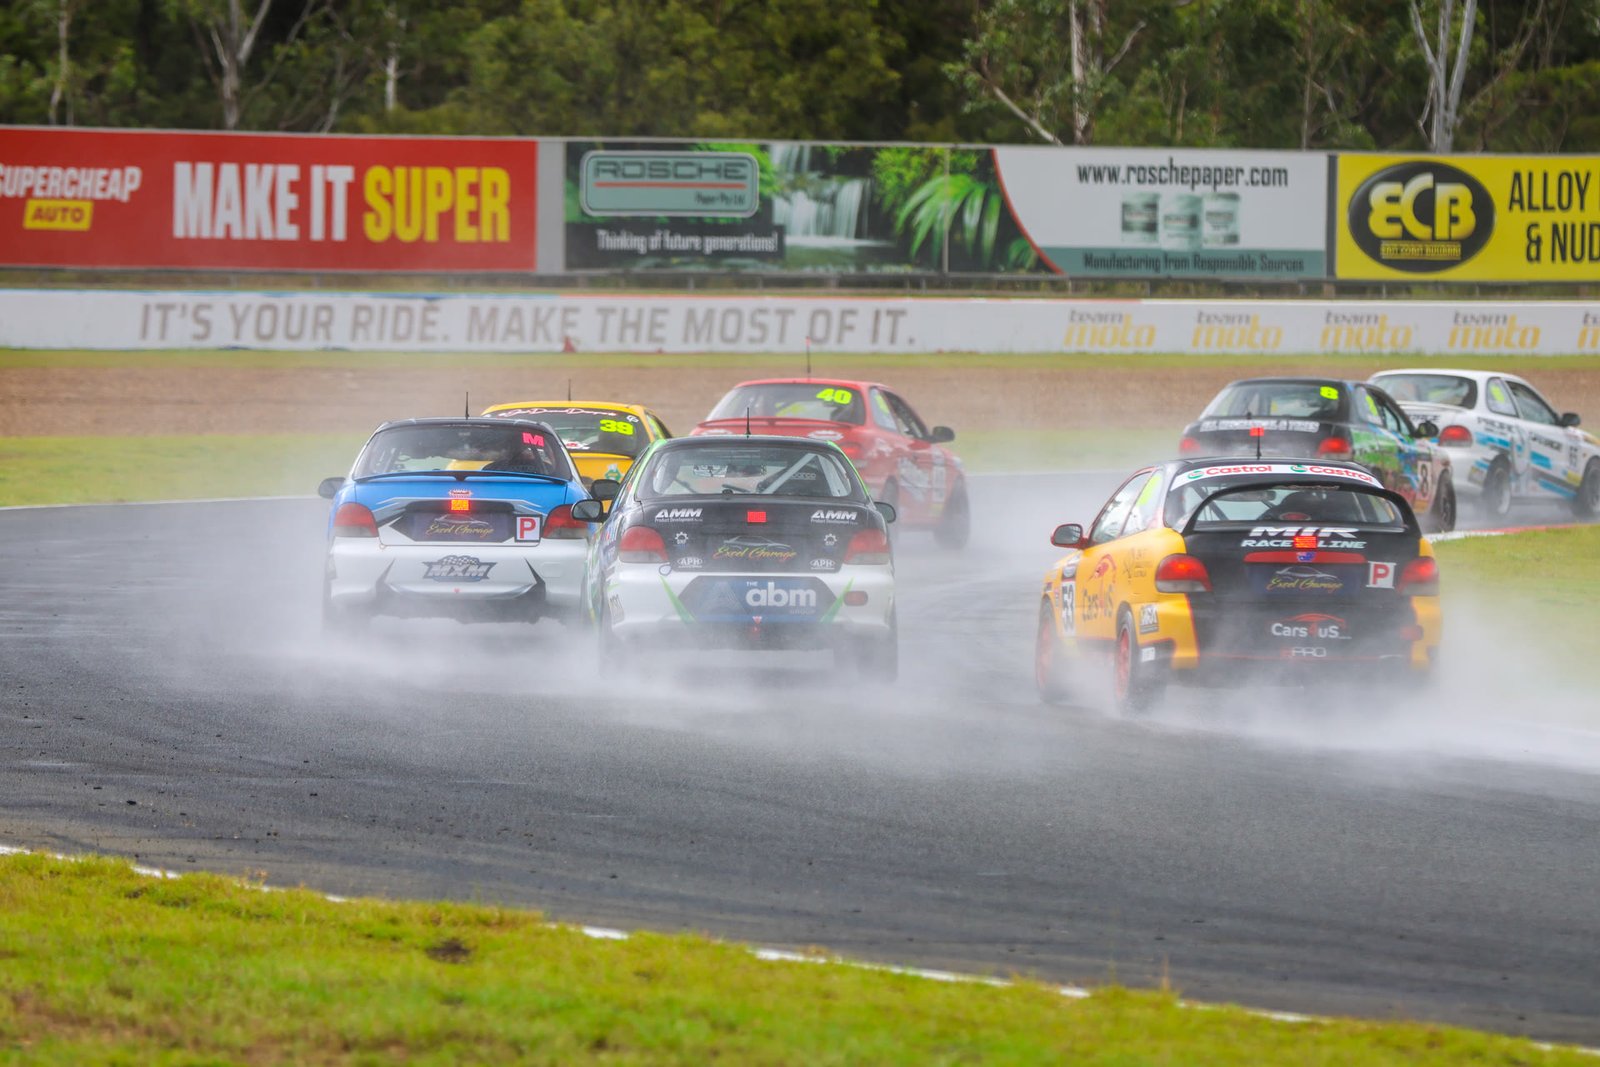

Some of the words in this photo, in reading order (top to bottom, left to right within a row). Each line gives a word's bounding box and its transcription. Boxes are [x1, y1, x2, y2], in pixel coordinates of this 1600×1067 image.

[593, 160, 748, 180] ROSCHE
[1077, 157, 1289, 192] www.roschepaper.com
[1508, 170, 1590, 212] ALLOY
[173, 161, 300, 240] MAKE
[310, 164, 355, 241] IT
[363, 165, 511, 243] SUPER
[1368, 172, 1476, 241] ECB
[31, 207, 85, 222] AUTO
[597, 229, 647, 254] Thinking
[648, 230, 663, 250] of
[663, 230, 702, 251] future
[703, 231, 778, 254] generations!
[1526, 221, 1542, 262] &
[1083, 252, 1161, 273] Manufacturing
[1164, 254, 1190, 271] from
[1194, 254, 1256, 274] Responsible
[1260, 255, 1304, 272] Sources
[139, 302, 213, 341] IT'S
[229, 302, 336, 342] YOUR
[349, 303, 450, 343] RIDE.
[465, 305, 580, 345] MAKE
[596, 306, 669, 345] THE
[682, 307, 795, 346] MOST
[807, 308, 859, 346] OF
[869, 309, 916, 347] IT.
[1070, 309, 1123, 324] team
[1197, 310, 1250, 324] team
[1325, 311, 1378, 325] team
[1454, 311, 1507, 325] team
[1063, 314, 1156, 348] moto
[1191, 314, 1283, 349] moto
[1320, 314, 1412, 349] moto
[1447, 314, 1541, 349] moto
[816, 387, 852, 405] 40
[1320, 386, 1338, 400] 8
[600, 419, 633, 436] 39
[522, 432, 545, 447] M
[1206, 465, 1272, 477] Castrol
[1309, 466, 1374, 483] Castrol
[1419, 460, 1428, 499] 8
[655, 508, 703, 518] AMM
[811, 509, 858, 520] AMM
[520, 518, 537, 539] P
[1249, 526, 1359, 538] MIR
[1240, 539, 1292, 548] RACE
[1317, 540, 1368, 549] LINE
[680, 557, 701, 565] APH
[713, 547, 748, 560] Excel
[749, 548, 797, 562] Garage
[813, 559, 832, 567] APH
[428, 564, 491, 577] MXM
[1372, 563, 1390, 585] P
[745, 581, 816, 607] abm
